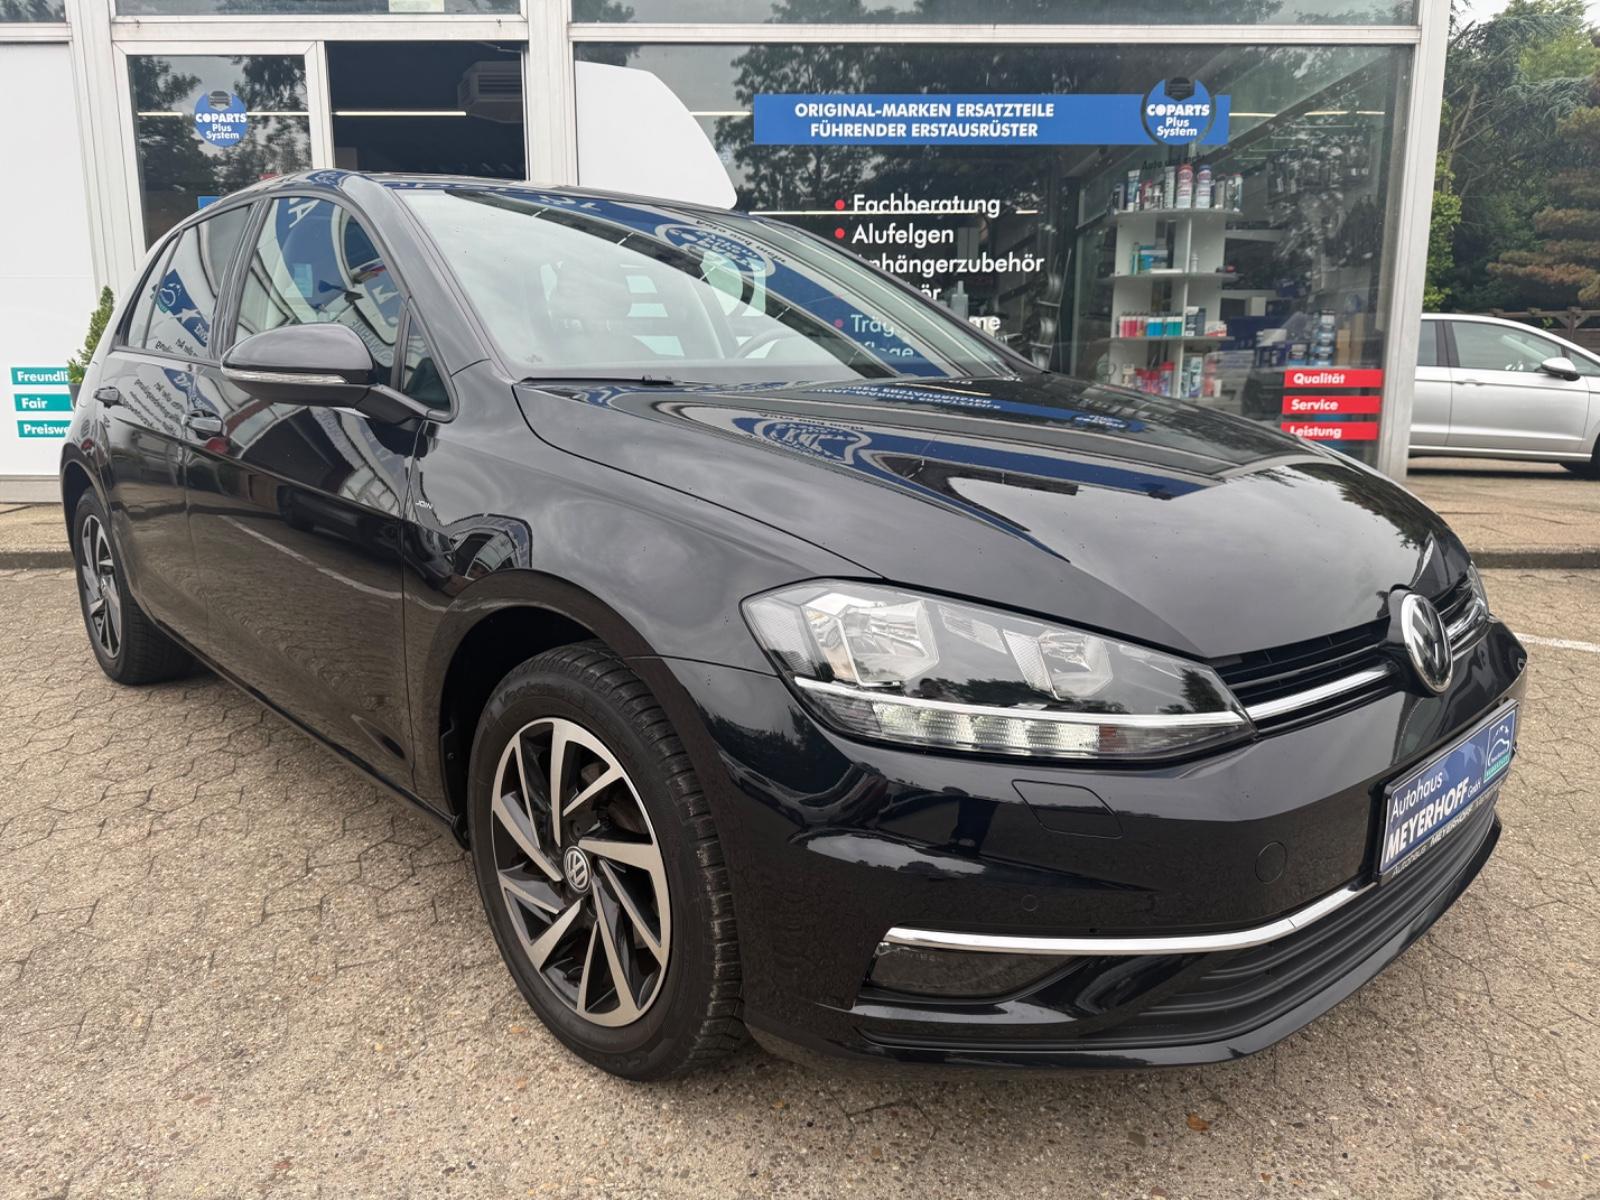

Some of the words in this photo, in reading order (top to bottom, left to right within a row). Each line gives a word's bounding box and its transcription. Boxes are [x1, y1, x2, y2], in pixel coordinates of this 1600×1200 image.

[794, 103, 951, 118] ORIGINAL-MARKEN
[956, 103, 1054, 117] ERSATZTEILE
[1147, 103, 1210, 116] COPARTS
[195, 113, 247, 123] COPARTS
[1165, 117, 1189, 127] Plus
[212, 124, 232, 132] Plus
[811, 120, 907, 138] FÜHRENDER
[911, 120, 1038, 138] ERSTAUSRÜSTER
[1157, 126, 1197, 138] System
[206, 131, 239, 140] System
[853, 193, 1000, 218] Fachberatung
[851, 223, 954, 248] Alufelgen
[858, 252, 1044, 278] nhängerzubehör
[17, 371, 68, 382] Freundli
[1293, 373, 1345, 384] Qualität
[21, 398, 48, 409] Fair
[1291, 398, 1339, 410] Service
[1290, 425, 1342, 439] Leistung
[1391, 772, 1443, 823] Autohaus
[1386, 776, 1470, 863] MEYERHOFF
